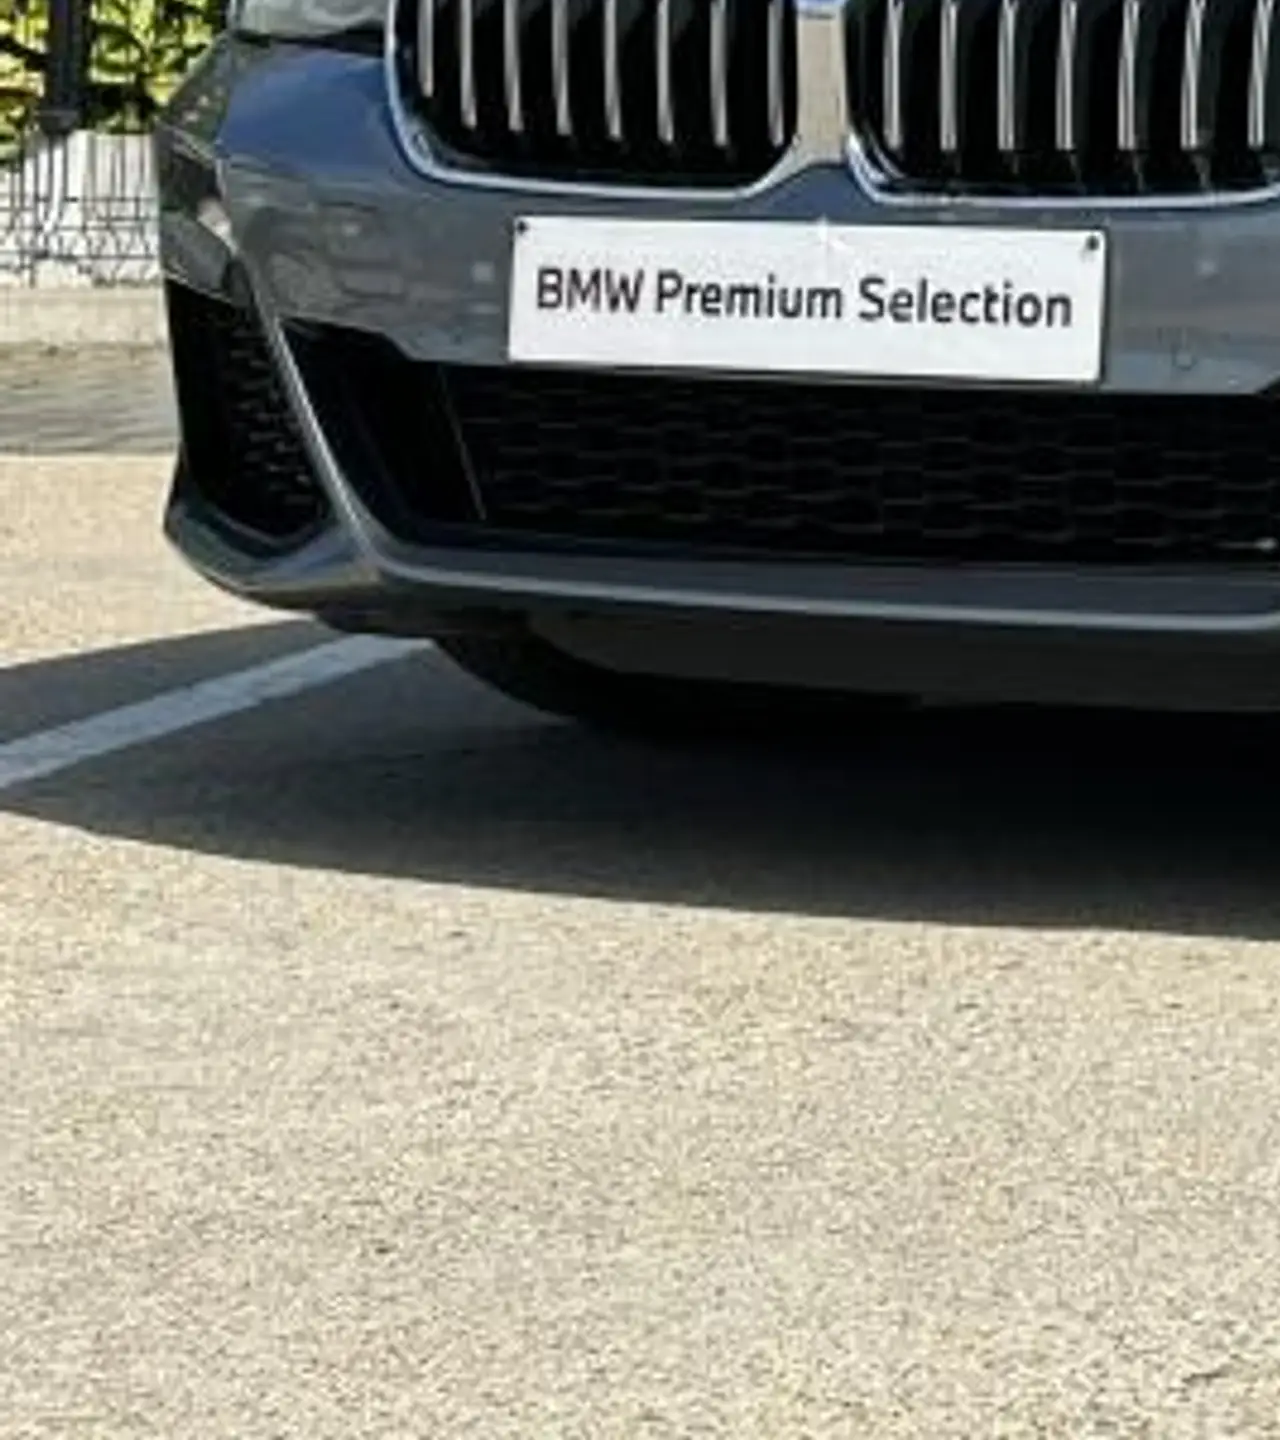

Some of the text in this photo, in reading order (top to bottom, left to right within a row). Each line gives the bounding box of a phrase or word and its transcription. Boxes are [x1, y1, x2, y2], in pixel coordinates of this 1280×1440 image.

[536, 267, 1073, 327] BMW Premium Selection
